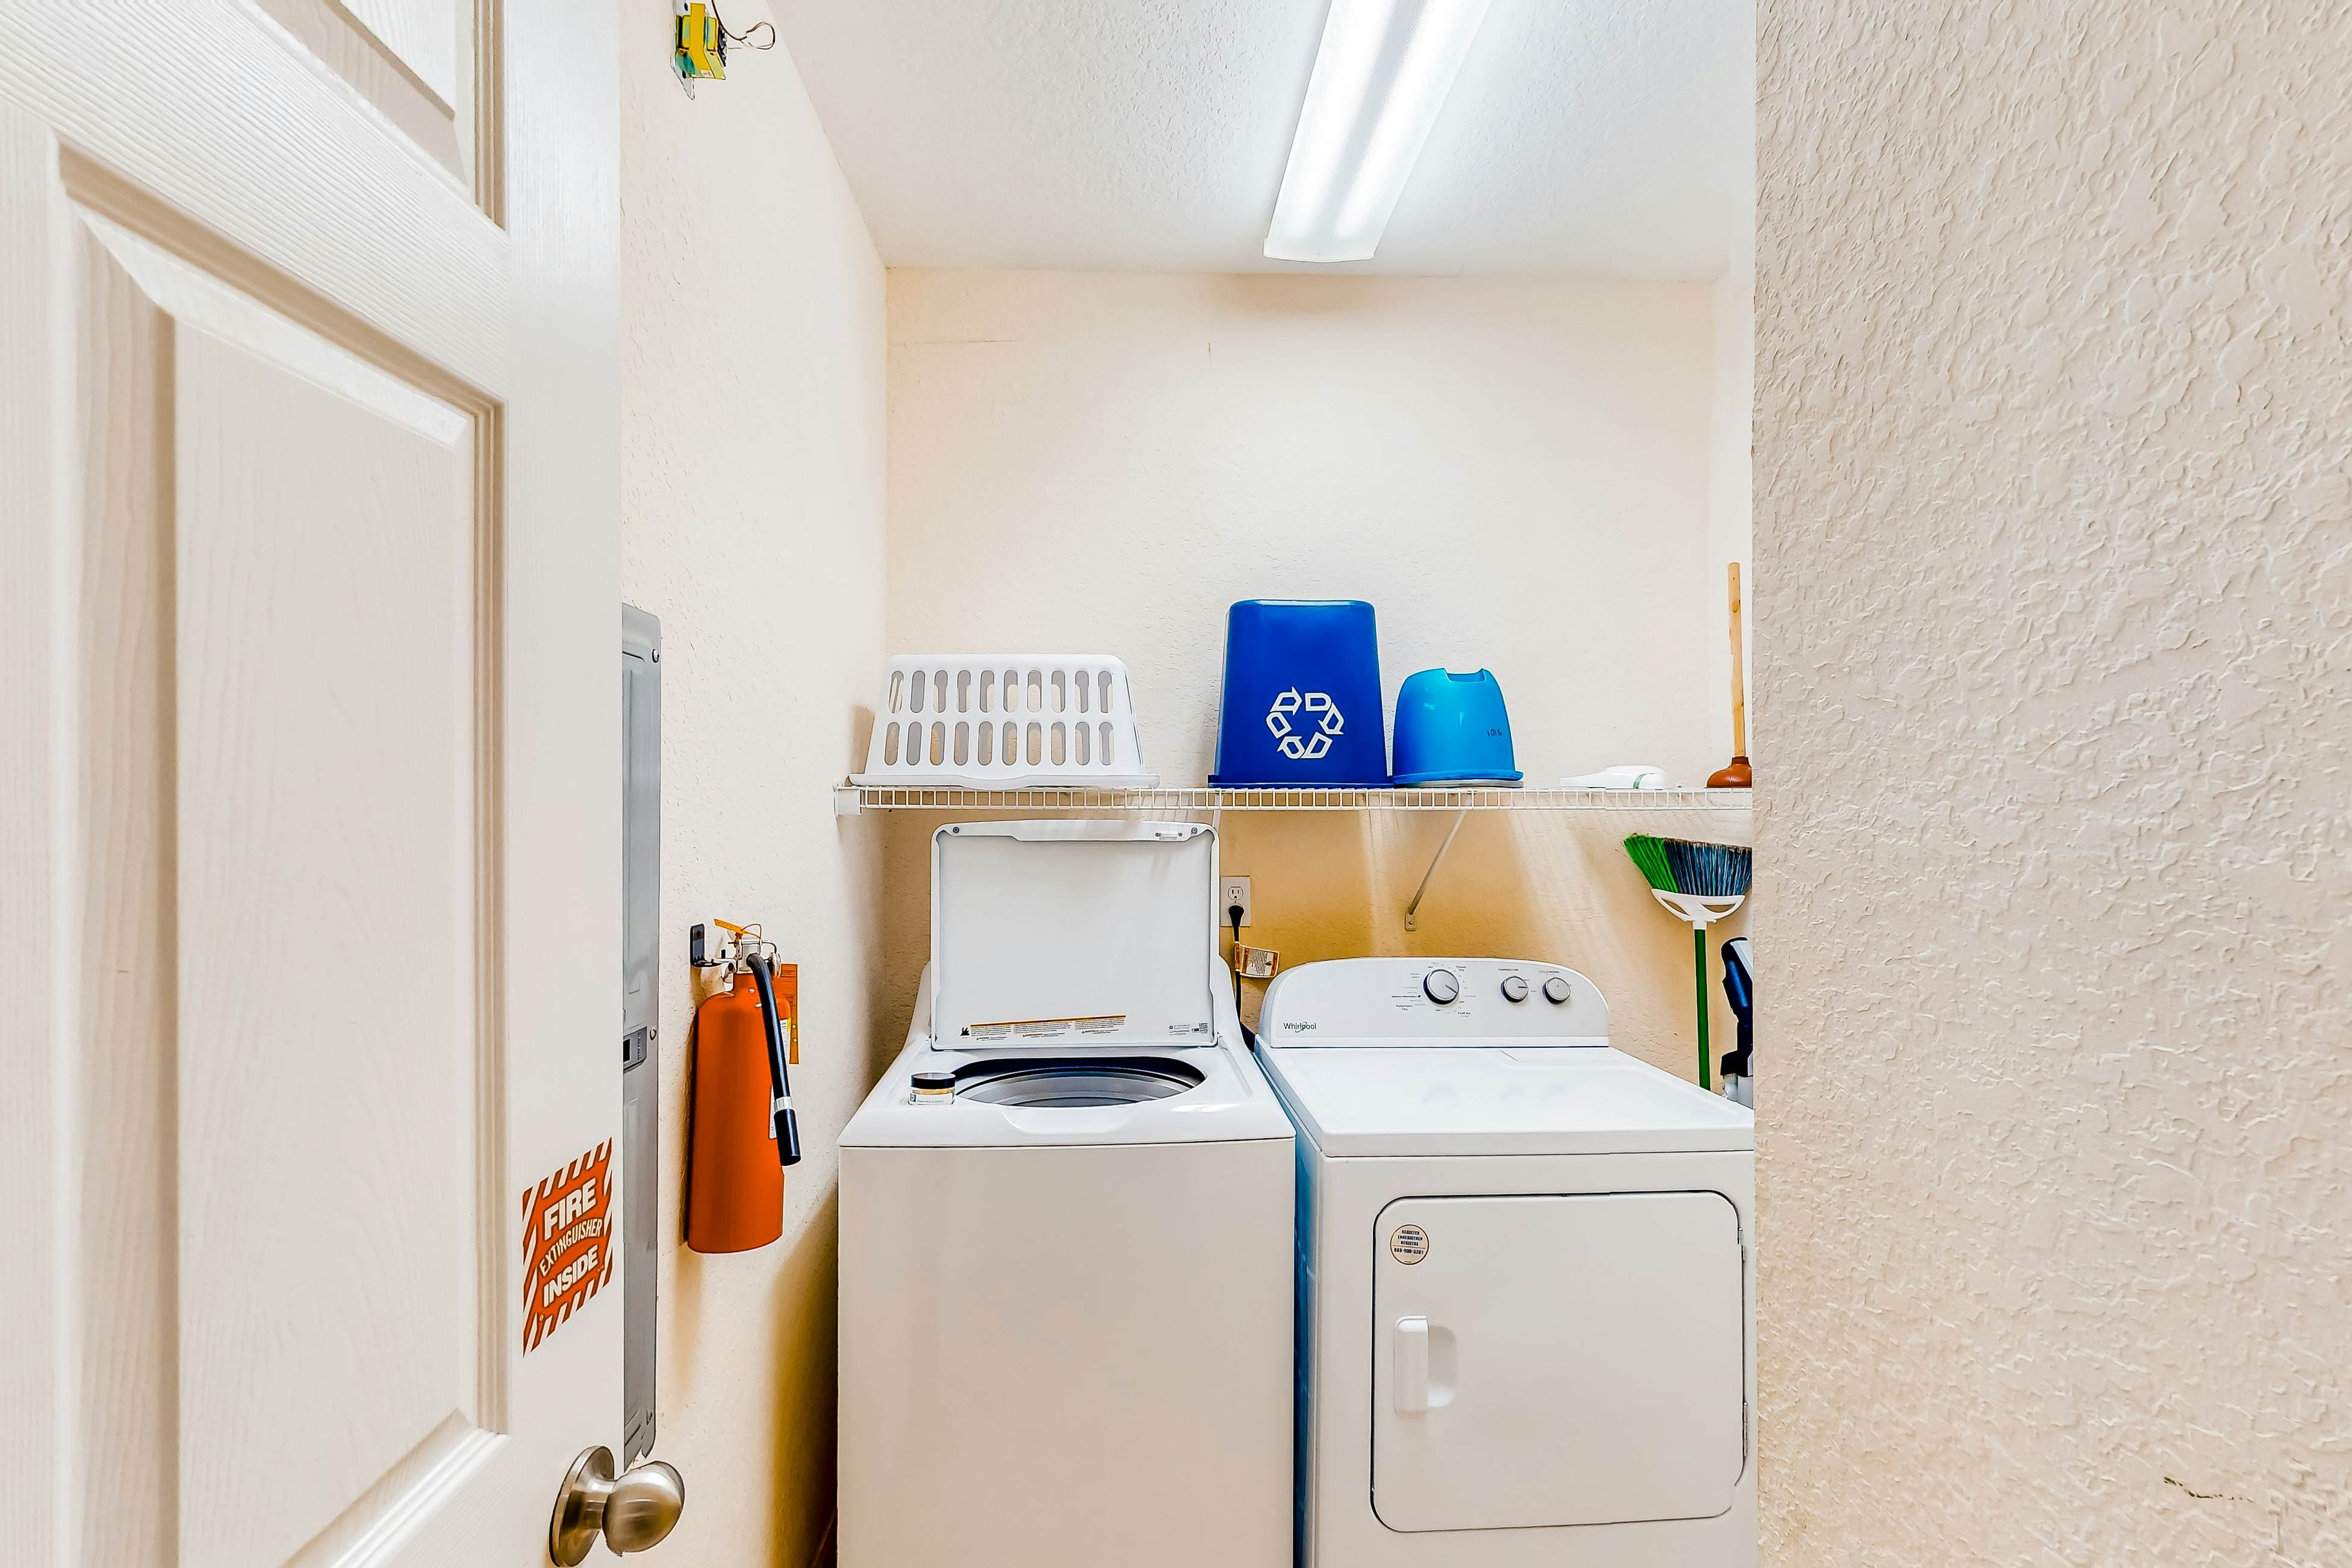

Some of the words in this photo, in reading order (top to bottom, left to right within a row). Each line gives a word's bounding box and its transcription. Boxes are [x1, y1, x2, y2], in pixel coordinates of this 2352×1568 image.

[1283, 1022, 1316, 1032] Whirlpool
[544, 1178, 596, 1240] FIRE
[540, 1218, 602, 1277] EXTINGUISHER
[543, 1245, 598, 1308] INSIDE
